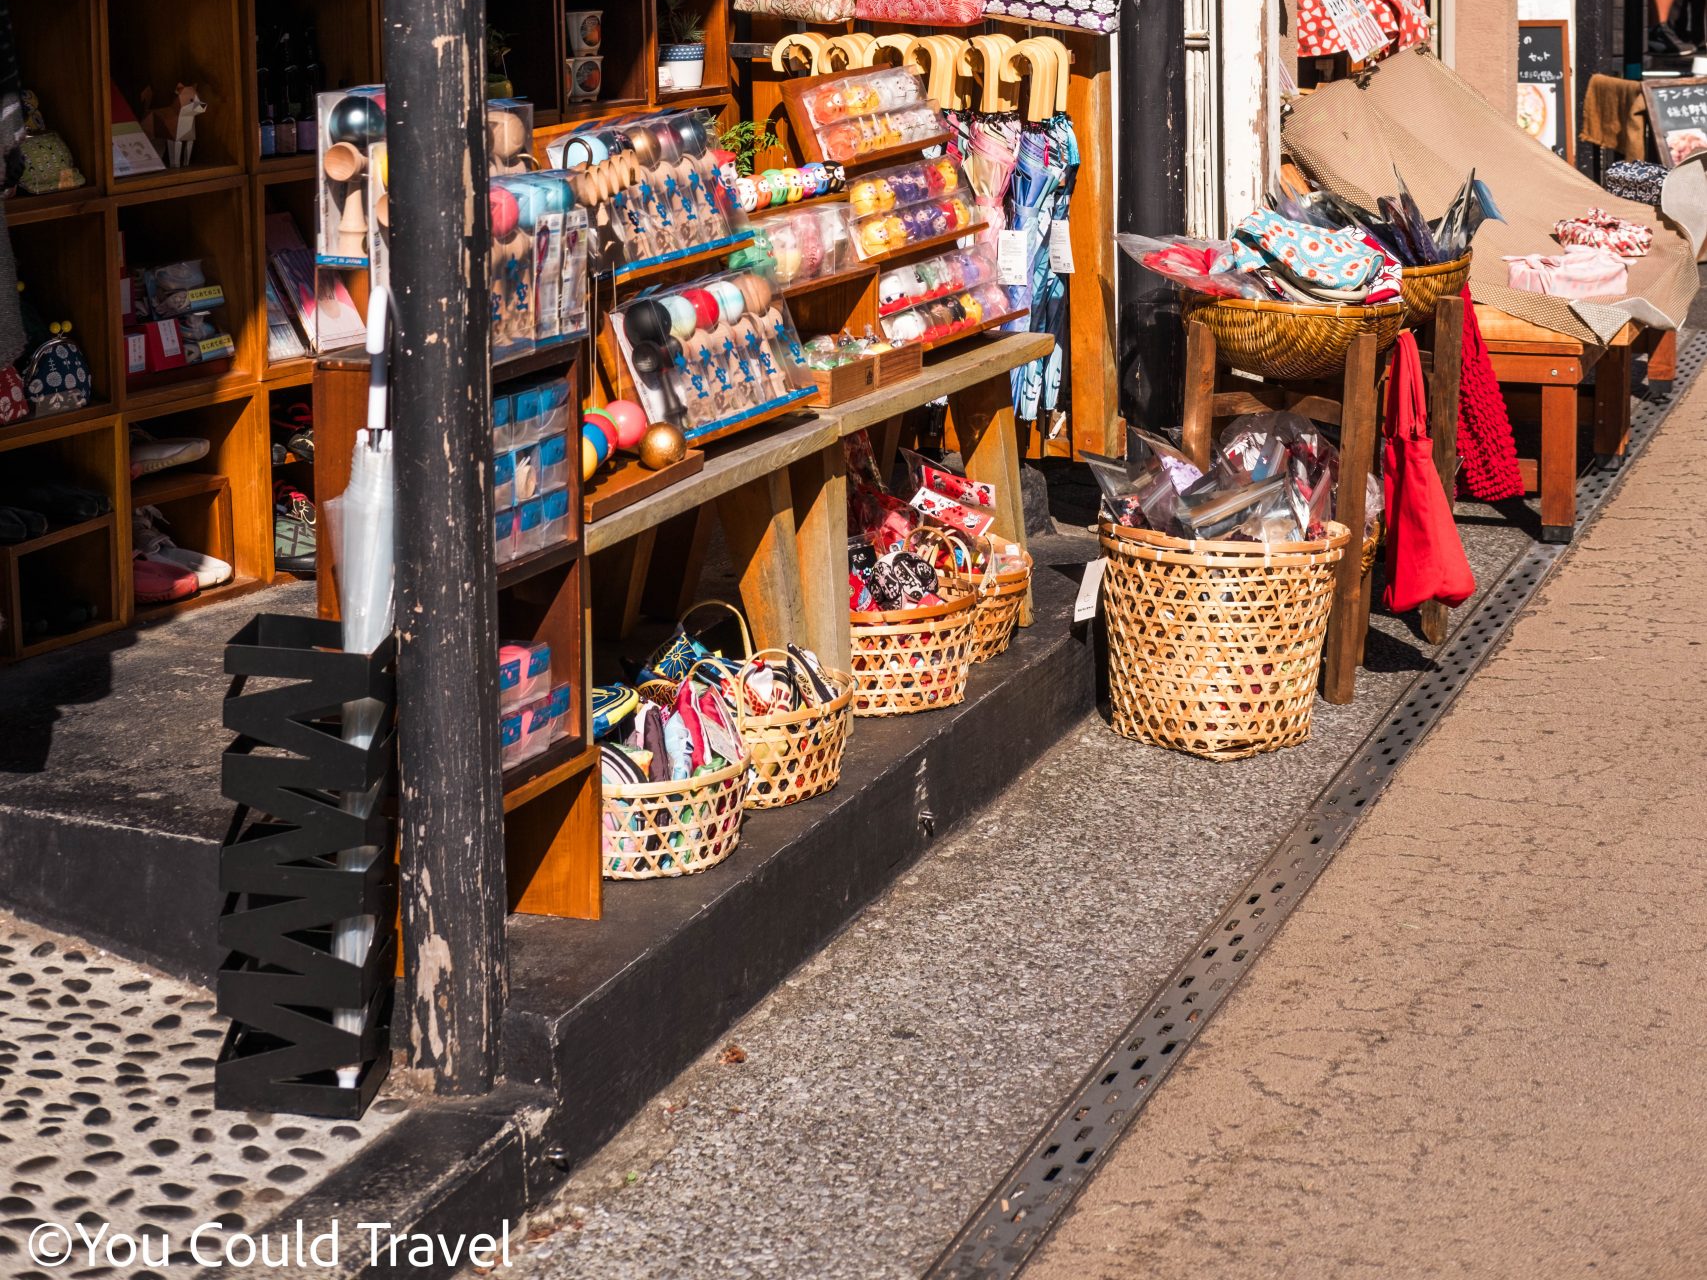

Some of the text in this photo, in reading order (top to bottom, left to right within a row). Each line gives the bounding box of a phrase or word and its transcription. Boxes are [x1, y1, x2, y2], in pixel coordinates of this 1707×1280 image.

[1527, 51, 1551, 62] セット
[1657, 86, 1707, 102] ランチセ
